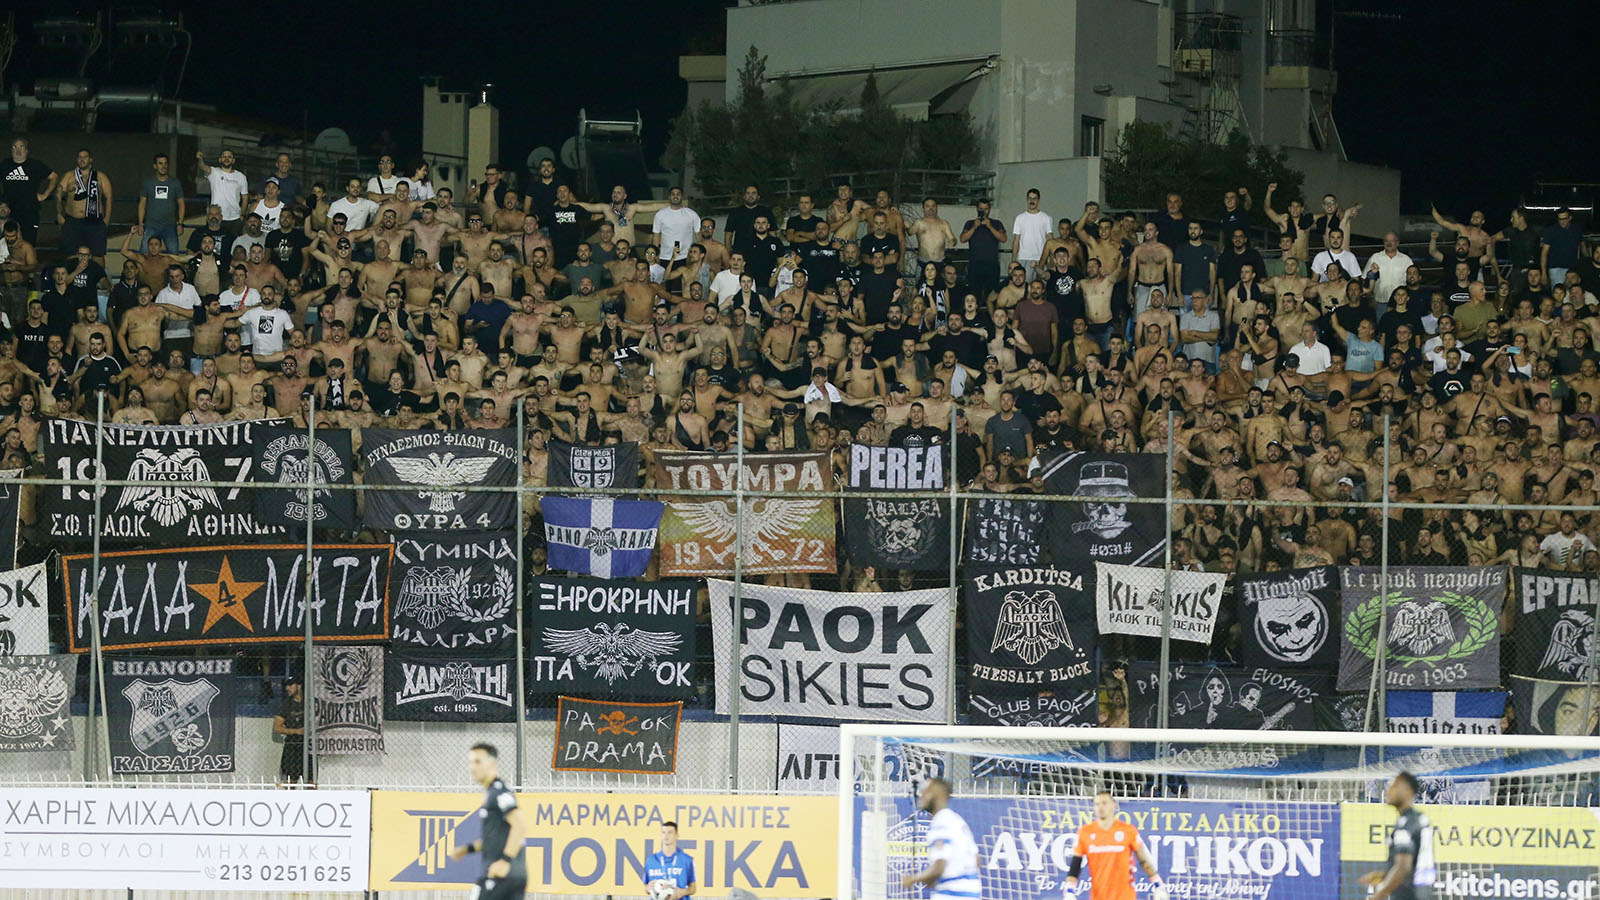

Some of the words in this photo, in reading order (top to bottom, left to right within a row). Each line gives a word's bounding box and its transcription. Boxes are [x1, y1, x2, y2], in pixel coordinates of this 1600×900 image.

[48, 419, 253, 446] ΠΑΝΕΛΛΗΝΙ
[367, 433, 441, 467] ΣΥΝΔΕΣΜΟΣ
[444, 433, 486, 450] ΦΙΛΩΝ
[148, 473, 192, 482] ΠΑΟΚ
[850, 443, 943, 489] PEREA
[394, 513, 467, 529] ΘΥΡΑ
[476, 512, 491, 528] 4
[549, 526, 581, 546] PANO
[673, 541, 700, 565] 19
[790, 538, 825, 562] 72
[465, 583, 501, 600] 1926
[974, 568, 1083, 592] KARDITSA
[1424, 567, 1502, 592] neapolis
[539, 583, 691, 615] ΞΗΡΟΚΡΗΝΗ
[730, 596, 934, 654] PAOK
[1109, 613, 1139, 625] PAOK
[1145, 616, 1163, 627] TIL
[112, 659, 232, 676] ΕΠΑΝΟΜΗ
[972, 663, 1044, 683] THESSALY
[1050, 661, 1092, 682] BLOCK
[1383, 669, 1415, 686] ince
[1422, 663, 1468, 686] 1963
[740, 655, 934, 711] SIKIES
[1251, 668, 1320, 704] EVOSMOS
[346, 696, 378, 728] FANS
[988, 699, 1031, 718] CLUB
[1038, 698, 1082, 715] PAOK
[308, 737, 385, 752] SDIROKASTRO
[565, 741, 667, 767] DRAMA
[113, 754, 231, 772] ΚΑΙΣΑΡΑΣ
[5, 800, 97, 825] ΧΑΡΗΣ
[107, 801, 353, 829] ΜΙΧΑΛΟΠΟΥΛΟΣ
[536, 803, 663, 827] ΜΑΡΜΑΡΑ
[675, 805, 791, 829] ΓΡΑΝΙΤΕΣ
[1042, 806, 1281, 834] ΣΑΝΟΥΪΤΣΑΔΙΚΟ
[1470, 826, 1596, 849] ΚΟΥΖΙΝΑΣ
[4, 842, 164, 858] ΣΥΜΒΟΥΛΟΙ
[195, 844, 352, 861] ΜΗΧΑΝΙΚΟΙ
[988, 832, 1324, 877] ΑΥΘΝΤΙΚΟΝ
[220, 865, 253, 881] 213
[260, 865, 307, 882] 0251
[314, 866, 351, 882] 625
